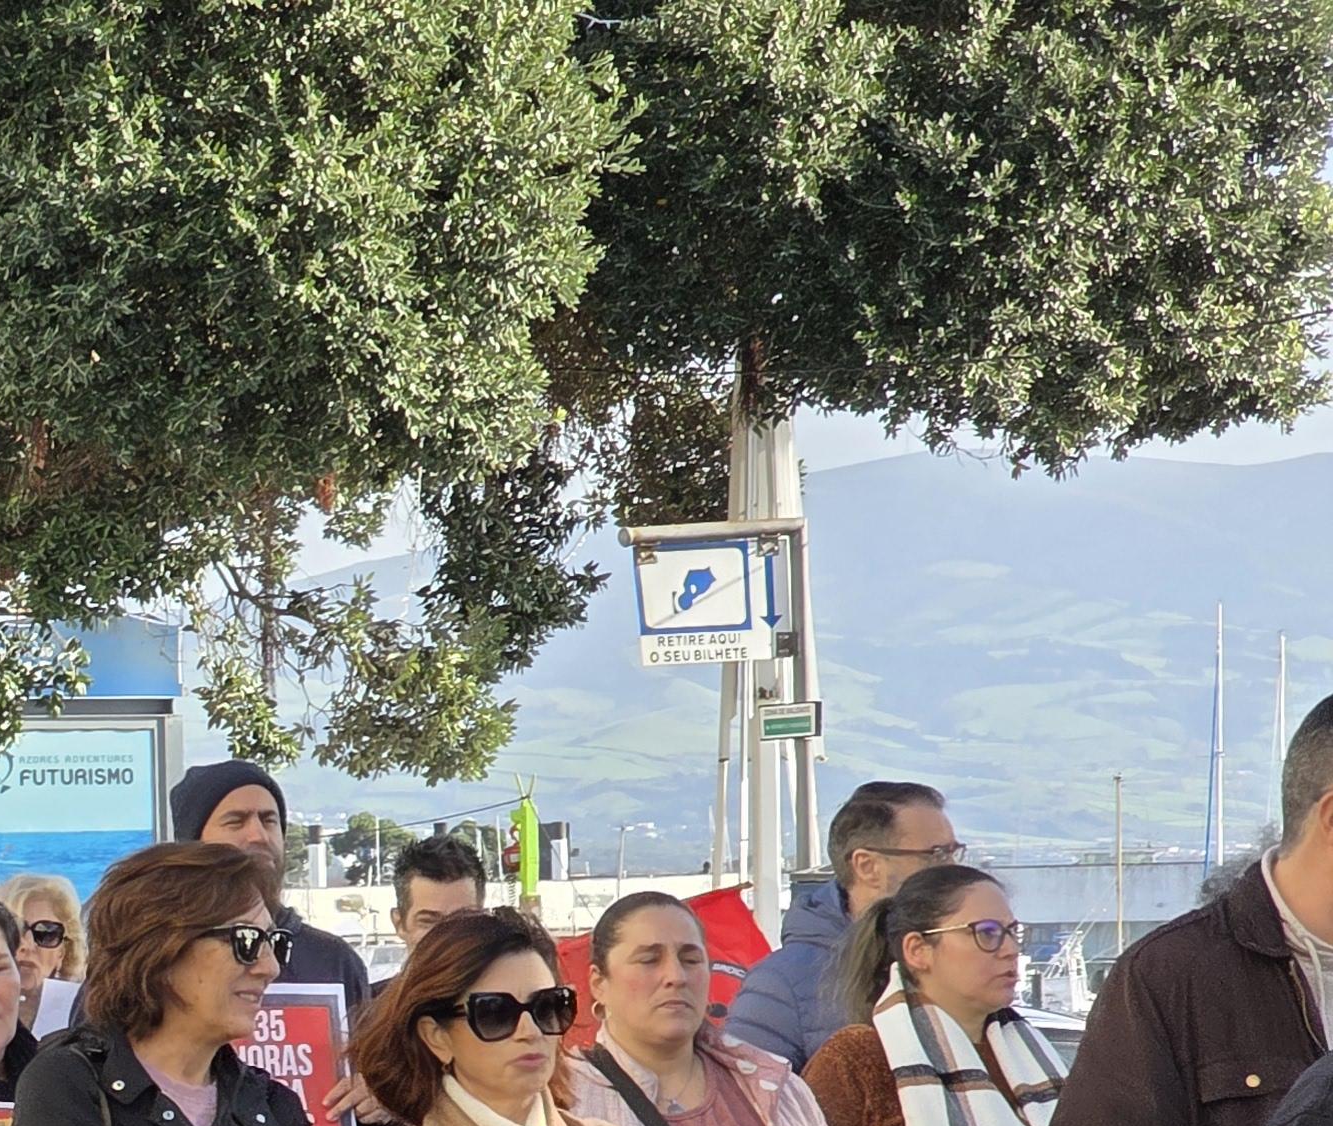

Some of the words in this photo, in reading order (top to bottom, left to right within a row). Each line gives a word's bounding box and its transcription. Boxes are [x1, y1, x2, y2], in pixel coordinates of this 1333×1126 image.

[657, 633, 706, 647] RETIRE
[709, 632, 741, 645] AQUI
[650, 651, 659, 663] O
[663, 650, 691, 663] SEU
[694, 647, 748, 662] BILHETE
[19, 754, 60, 765] AZORES
[64, 754, 134, 764] ADVENTURES
[19, 767, 134, 787] FUTURISMO
[253, 1009, 287, 1043] 35
